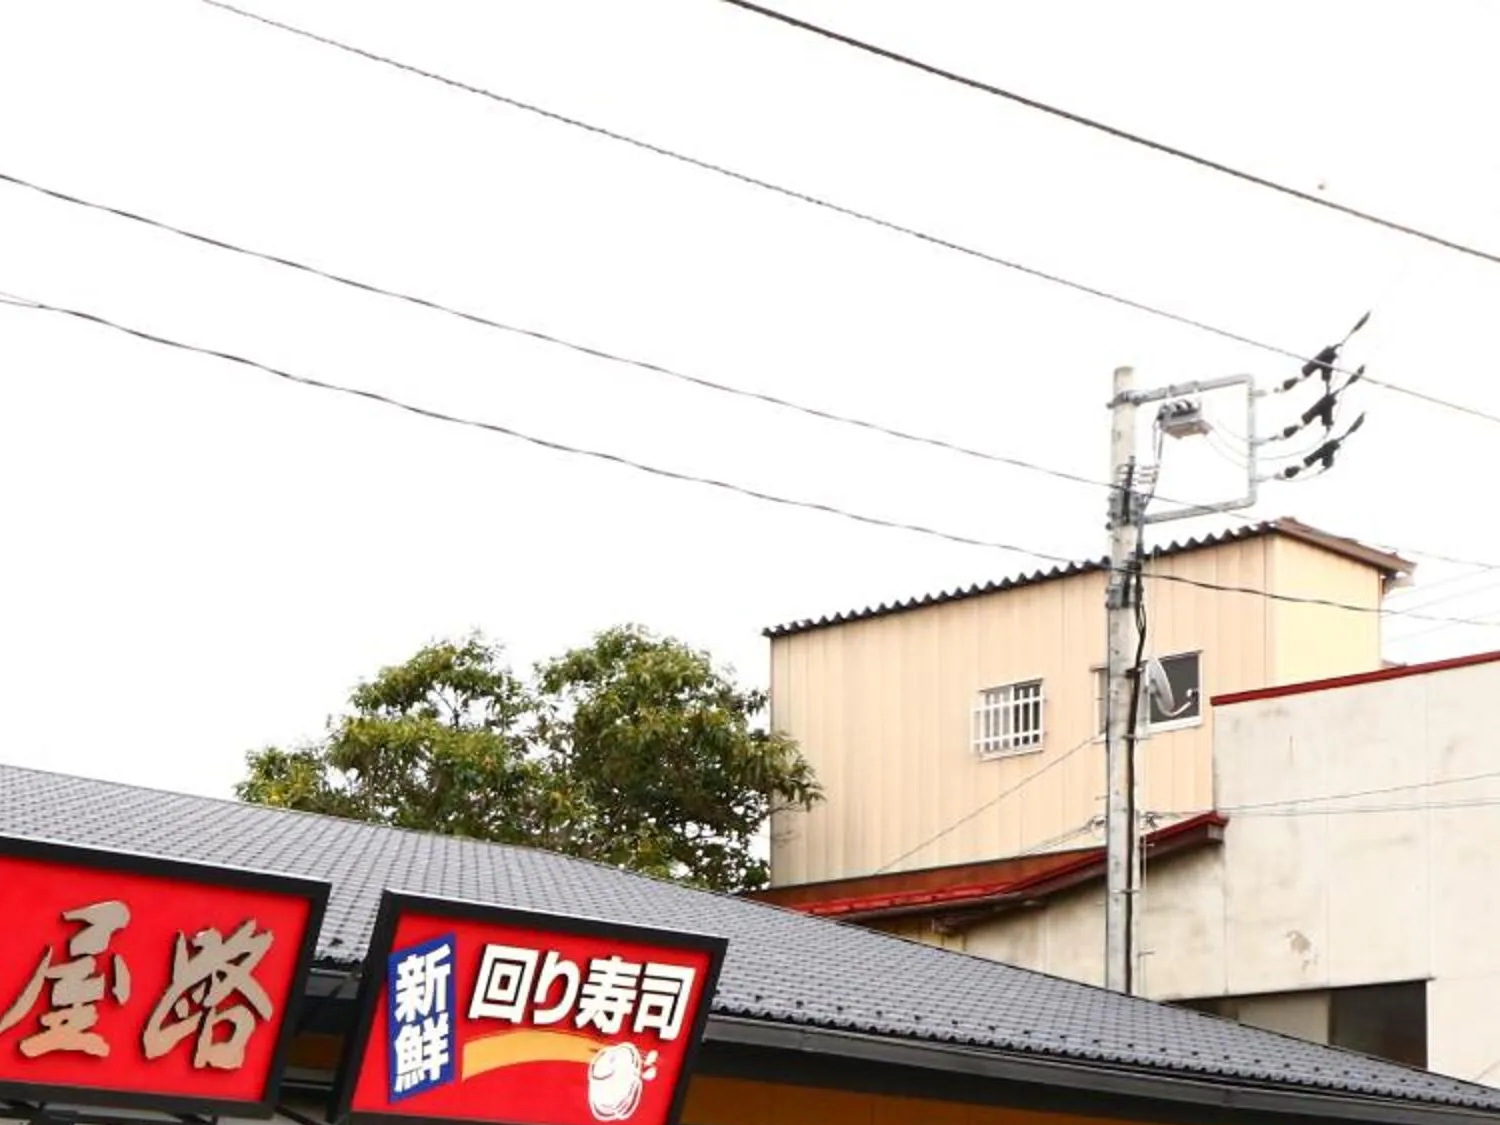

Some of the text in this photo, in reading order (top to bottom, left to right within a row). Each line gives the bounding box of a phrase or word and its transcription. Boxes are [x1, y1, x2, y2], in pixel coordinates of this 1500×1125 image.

[394, 943, 452, 1093] 新鮮
[468, 943, 696, 1040] 回り寿司
